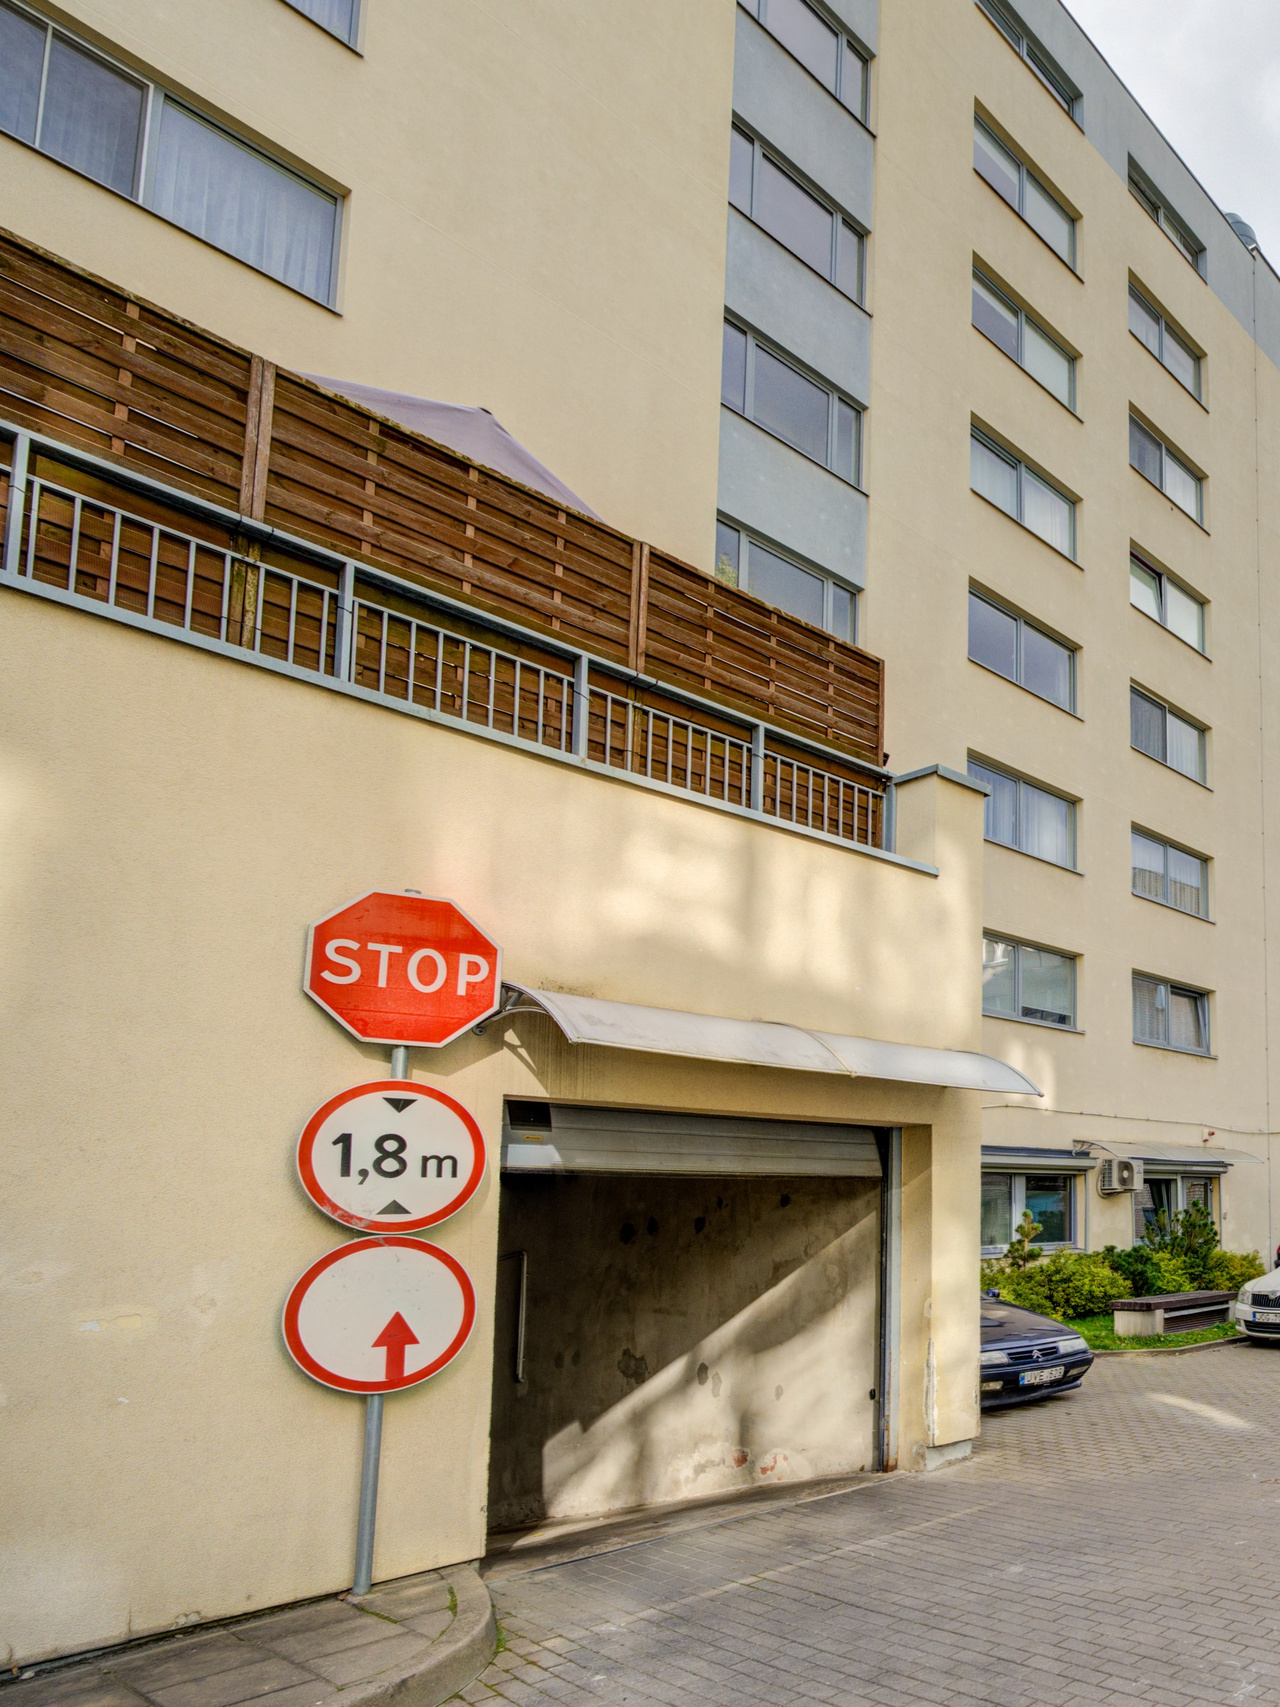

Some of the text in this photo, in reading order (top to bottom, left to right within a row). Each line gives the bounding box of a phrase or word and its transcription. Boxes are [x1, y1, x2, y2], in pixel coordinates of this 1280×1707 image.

[320, 938, 490, 996] STOP
[332, 1133, 458, 1185] 1,8 m
